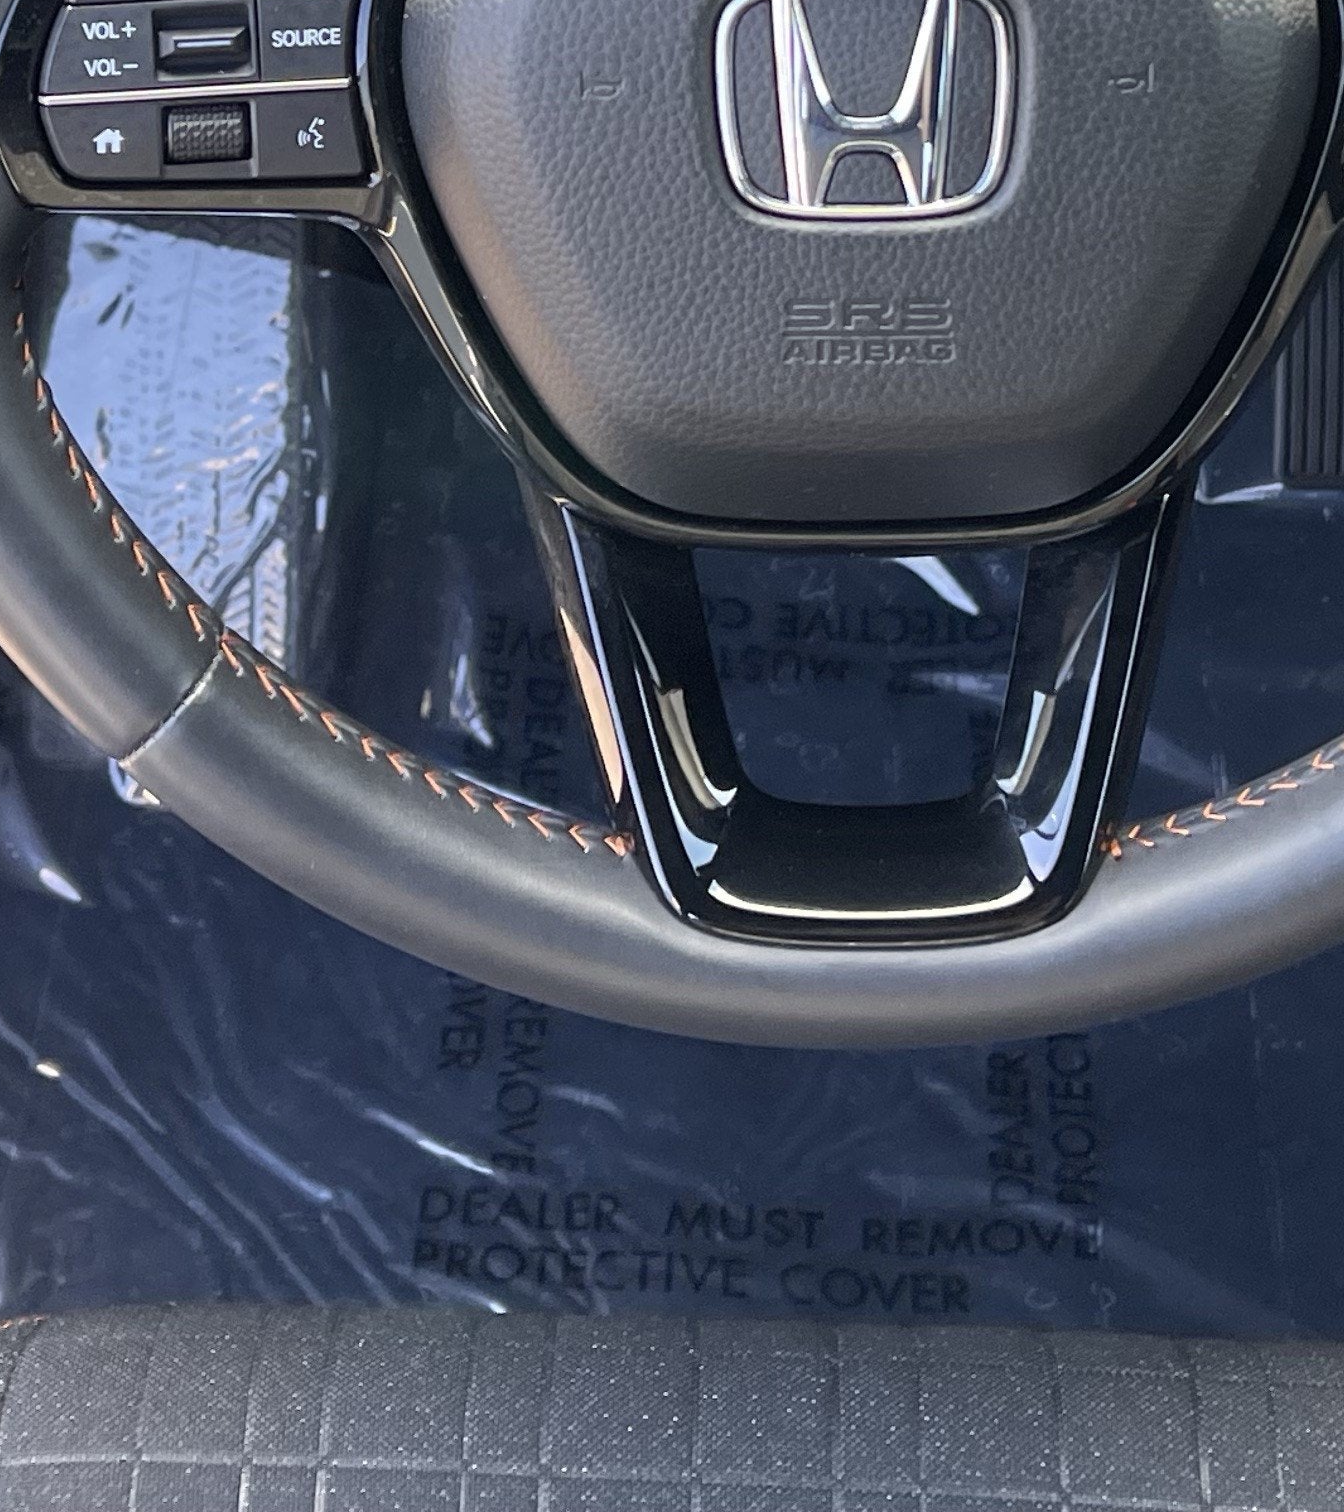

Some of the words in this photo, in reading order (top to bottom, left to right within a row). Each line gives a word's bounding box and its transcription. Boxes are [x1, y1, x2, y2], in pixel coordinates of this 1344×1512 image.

[270, 26, 342, 49] SOURCE
[783, 297, 953, 331] SRS
[782, 338, 957, 366] AIRBAG
[418, 1184, 625, 1234] DEALER
[667, 1202, 826, 1251] MUST
[861, 1216, 1101, 1264] REMOVE
[411, 1237, 749, 1300] PROTECTIVE
[781, 1265, 973, 1316] COVER
